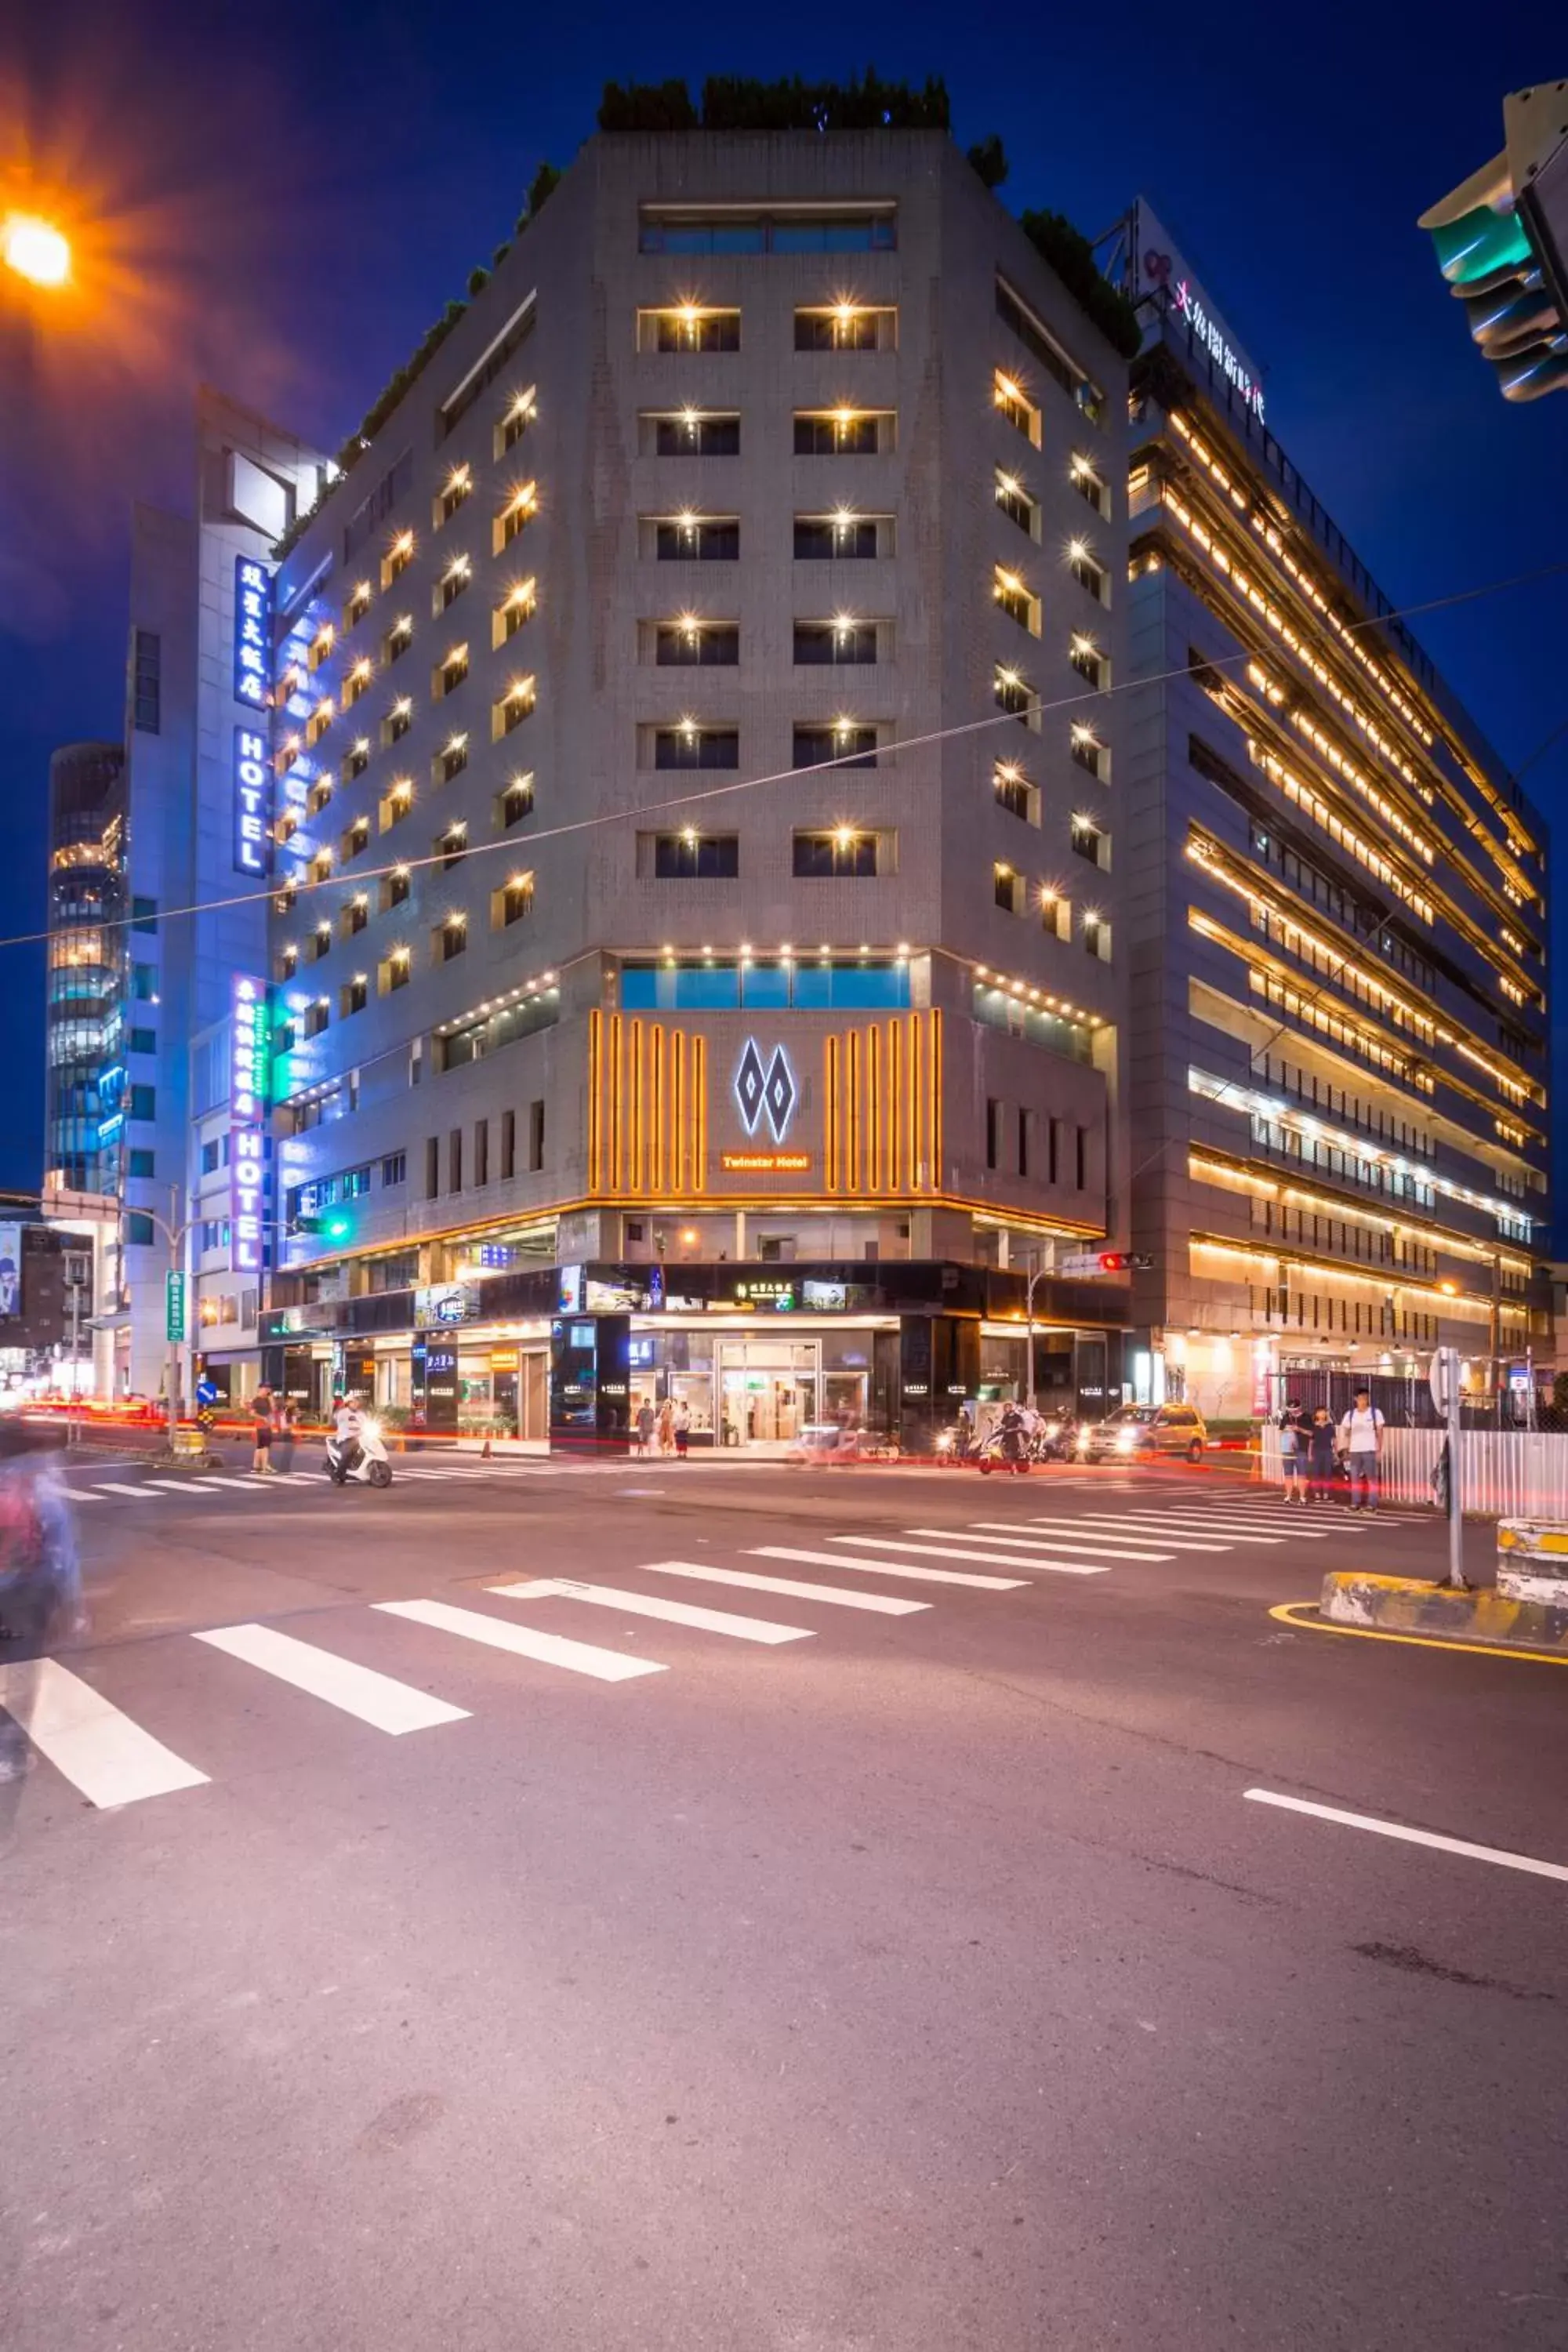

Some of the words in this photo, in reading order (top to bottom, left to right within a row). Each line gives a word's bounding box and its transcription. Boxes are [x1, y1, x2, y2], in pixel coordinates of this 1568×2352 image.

[240, 732, 265, 869] HOTEL
[237, 1132, 260, 1266] HOTEL
[724, 1156, 774, 1167] Twinstar
[776, 1156, 807, 1167] Hotel
